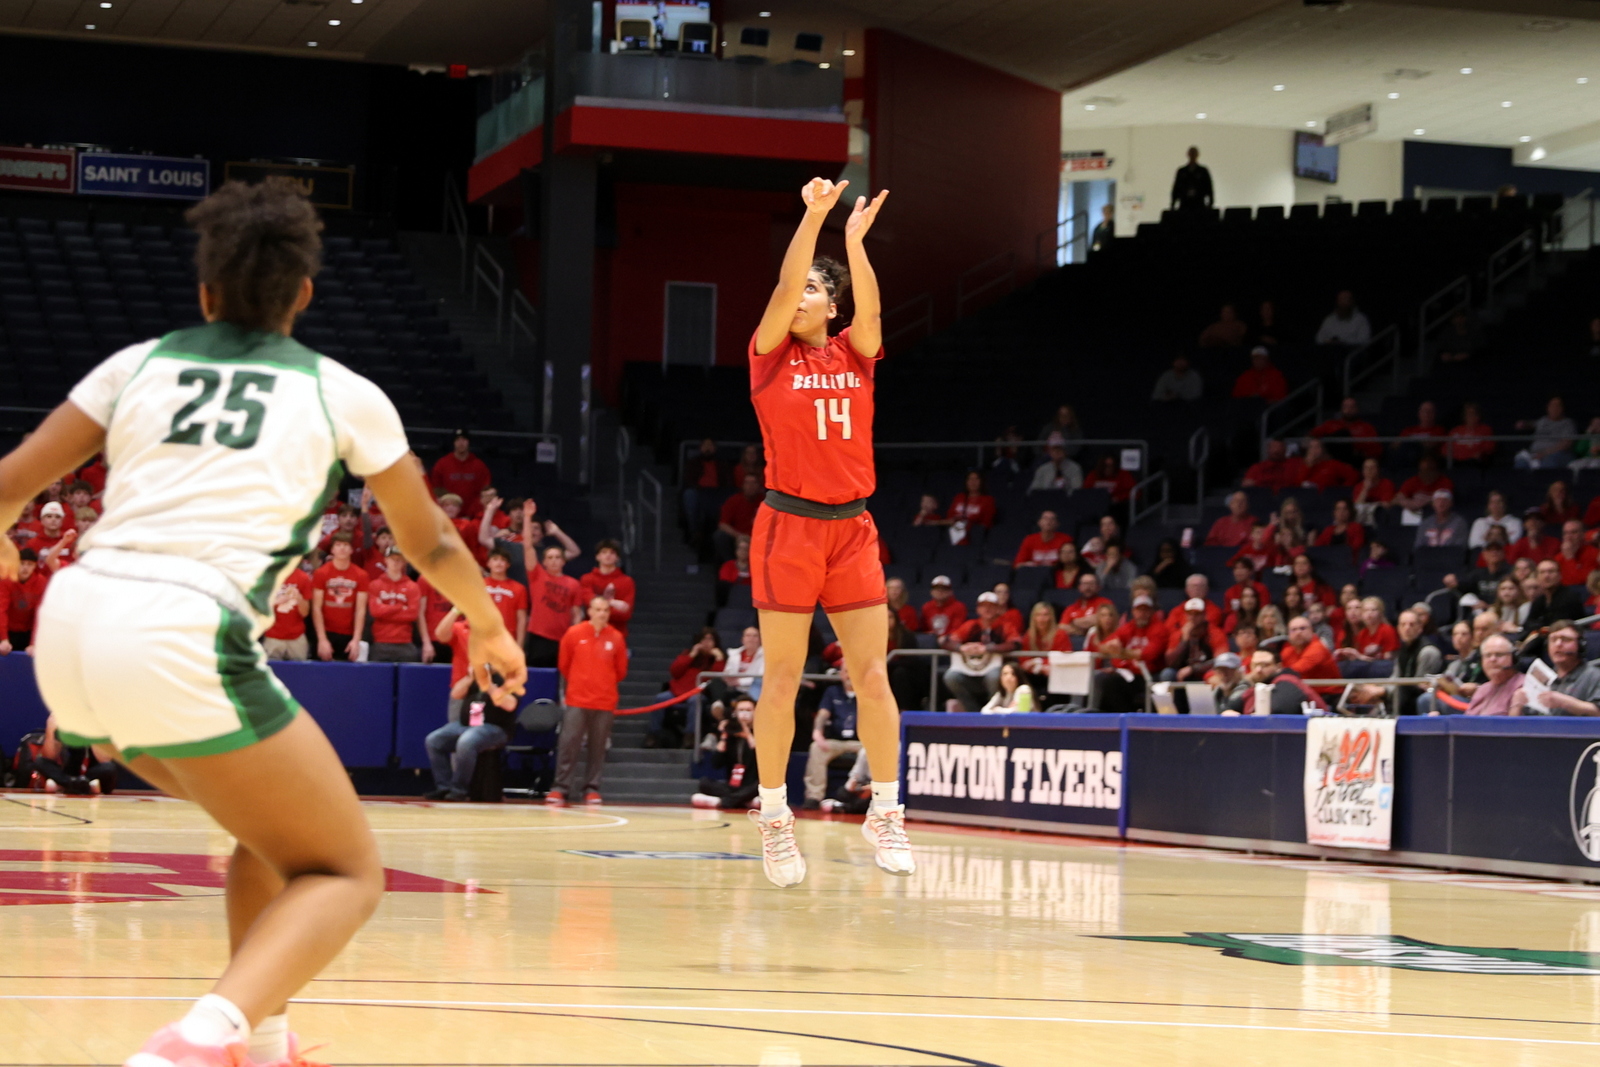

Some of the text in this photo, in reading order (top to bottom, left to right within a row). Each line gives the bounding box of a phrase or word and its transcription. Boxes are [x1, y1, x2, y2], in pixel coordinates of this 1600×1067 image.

[85, 165, 141, 183] SAINT
[149, 168, 204, 187] LOUIS
[162, 368, 277, 450] 25
[814, 398, 852, 440] 14
[907, 742, 1122, 809] DAYTON FLYERS
